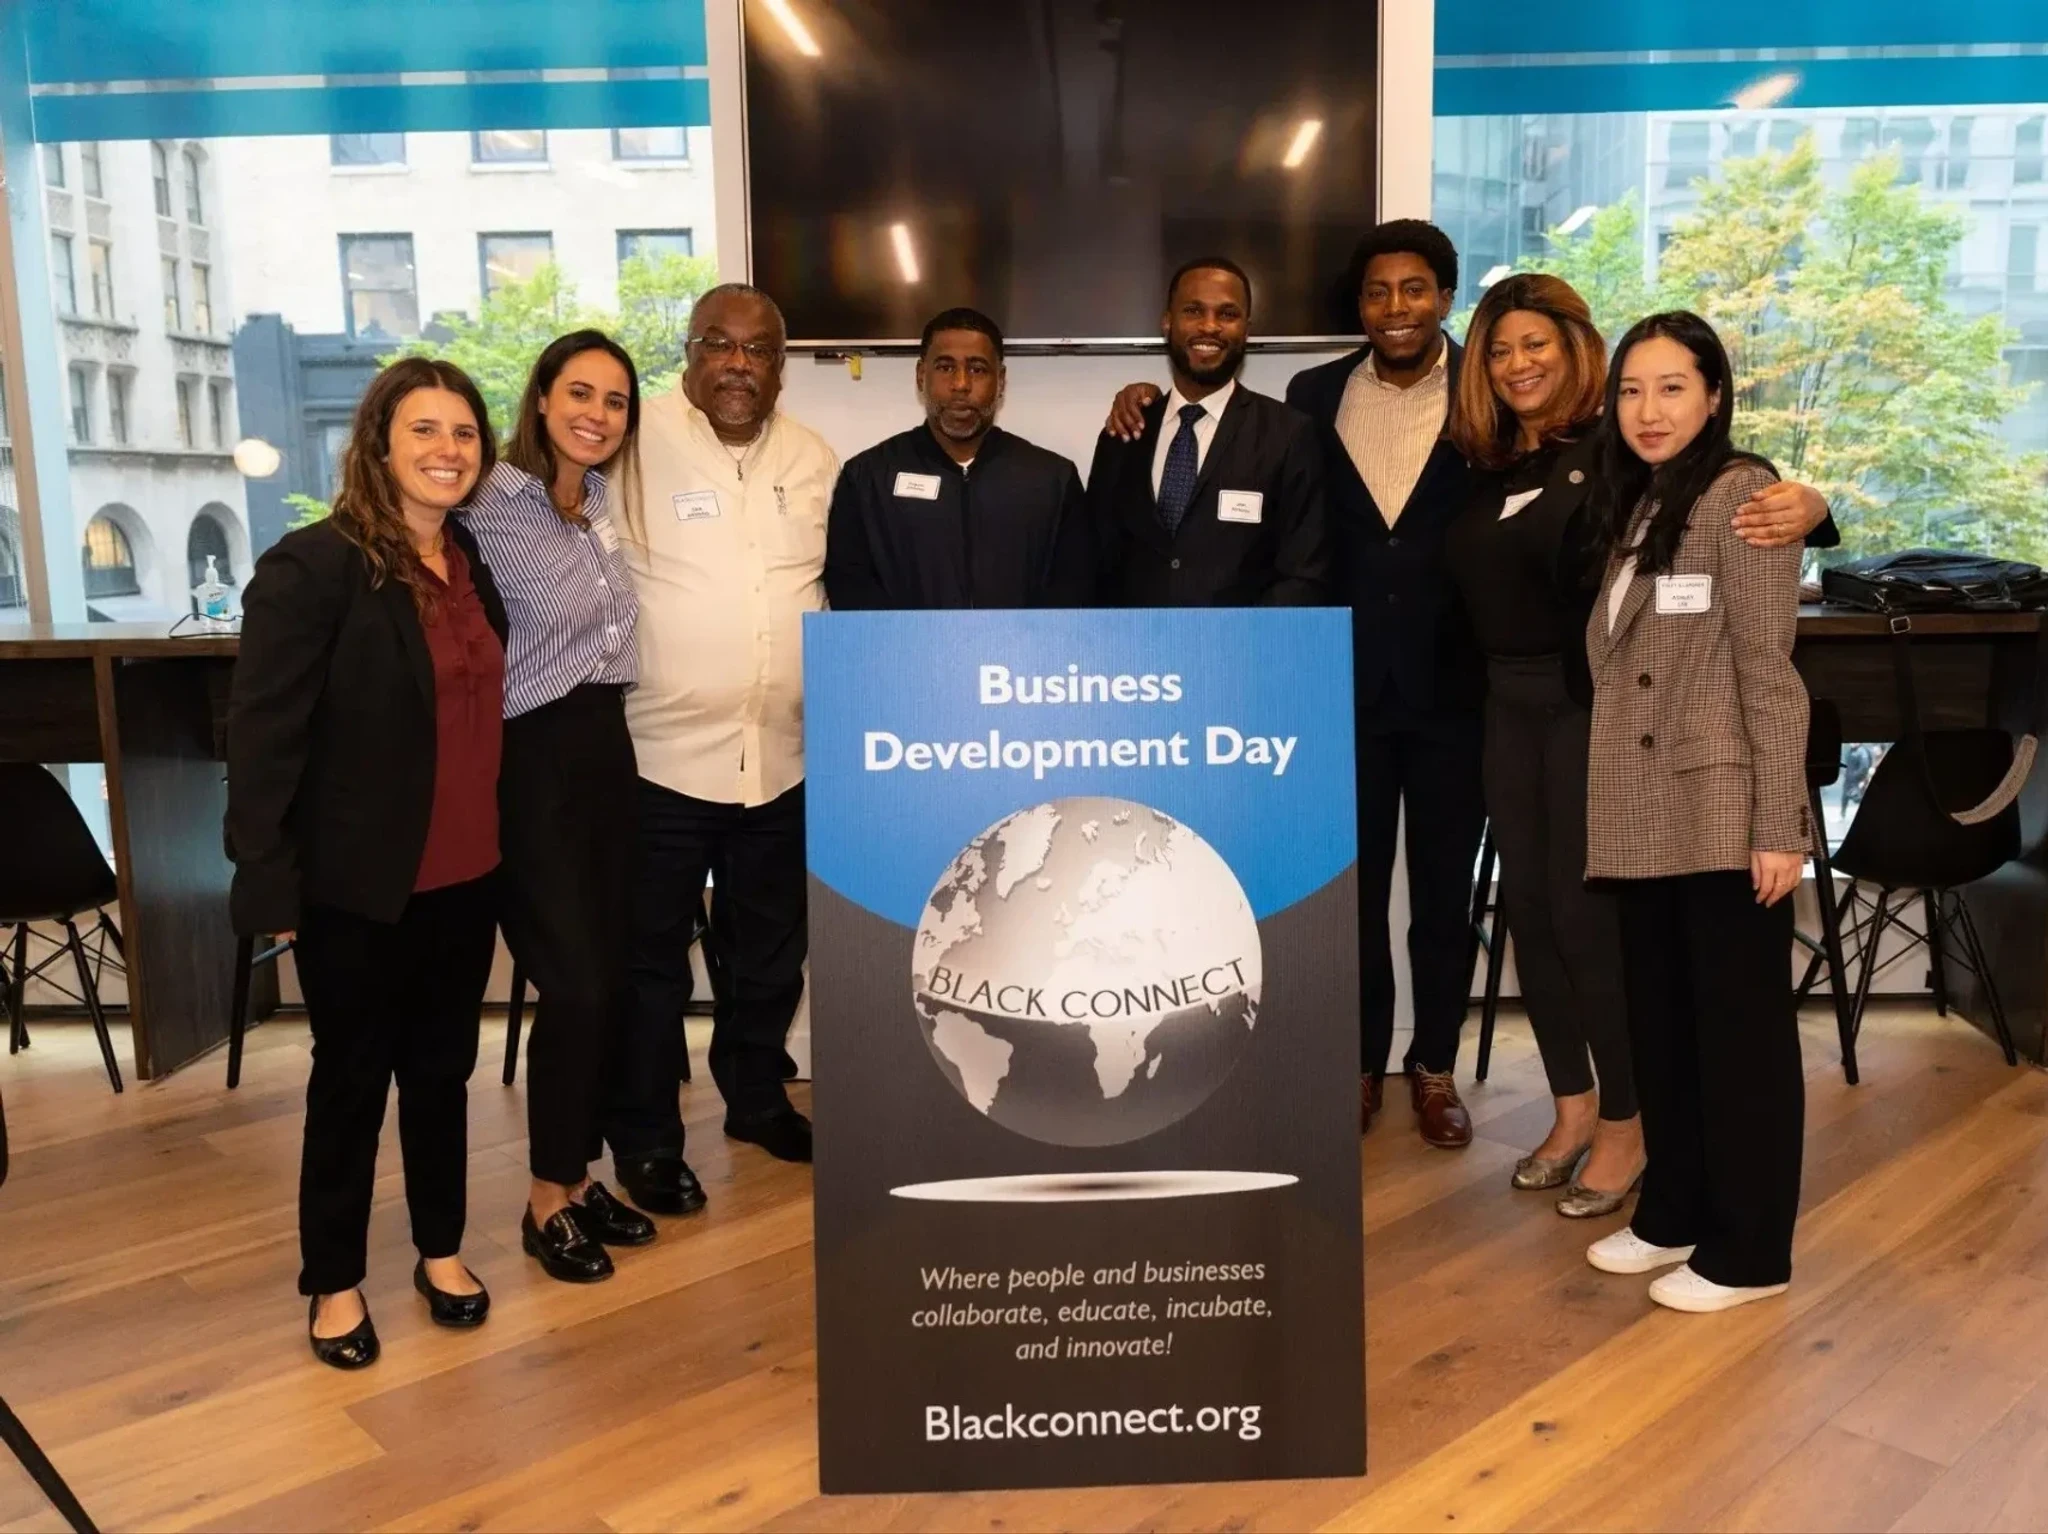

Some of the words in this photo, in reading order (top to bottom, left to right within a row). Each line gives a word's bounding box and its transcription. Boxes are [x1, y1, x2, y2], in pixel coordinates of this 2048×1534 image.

[979, 663, 1183, 705] Business
[864, 729, 1190, 780] Development
[1206, 726, 1297, 775] Day
[928, 965, 1046, 1017] BLACK
[1060, 956, 1247, 1019] CONNECT
[920, 1266, 1000, 1291] Where
[1007, 1262, 1086, 1295] people
[1092, 1260, 1137, 1286] and
[1143, 1259, 1266, 1284] businesses
[911, 1302, 1049, 1328] collaborate,
[1057, 1298, 1157, 1323] educate,
[1166, 1294, 1272, 1319] incubate,
[1015, 1335, 1060, 1360] and
[1066, 1331, 1173, 1358] innovate!
[925, 1402, 1262, 1442] Blackconnect.org
